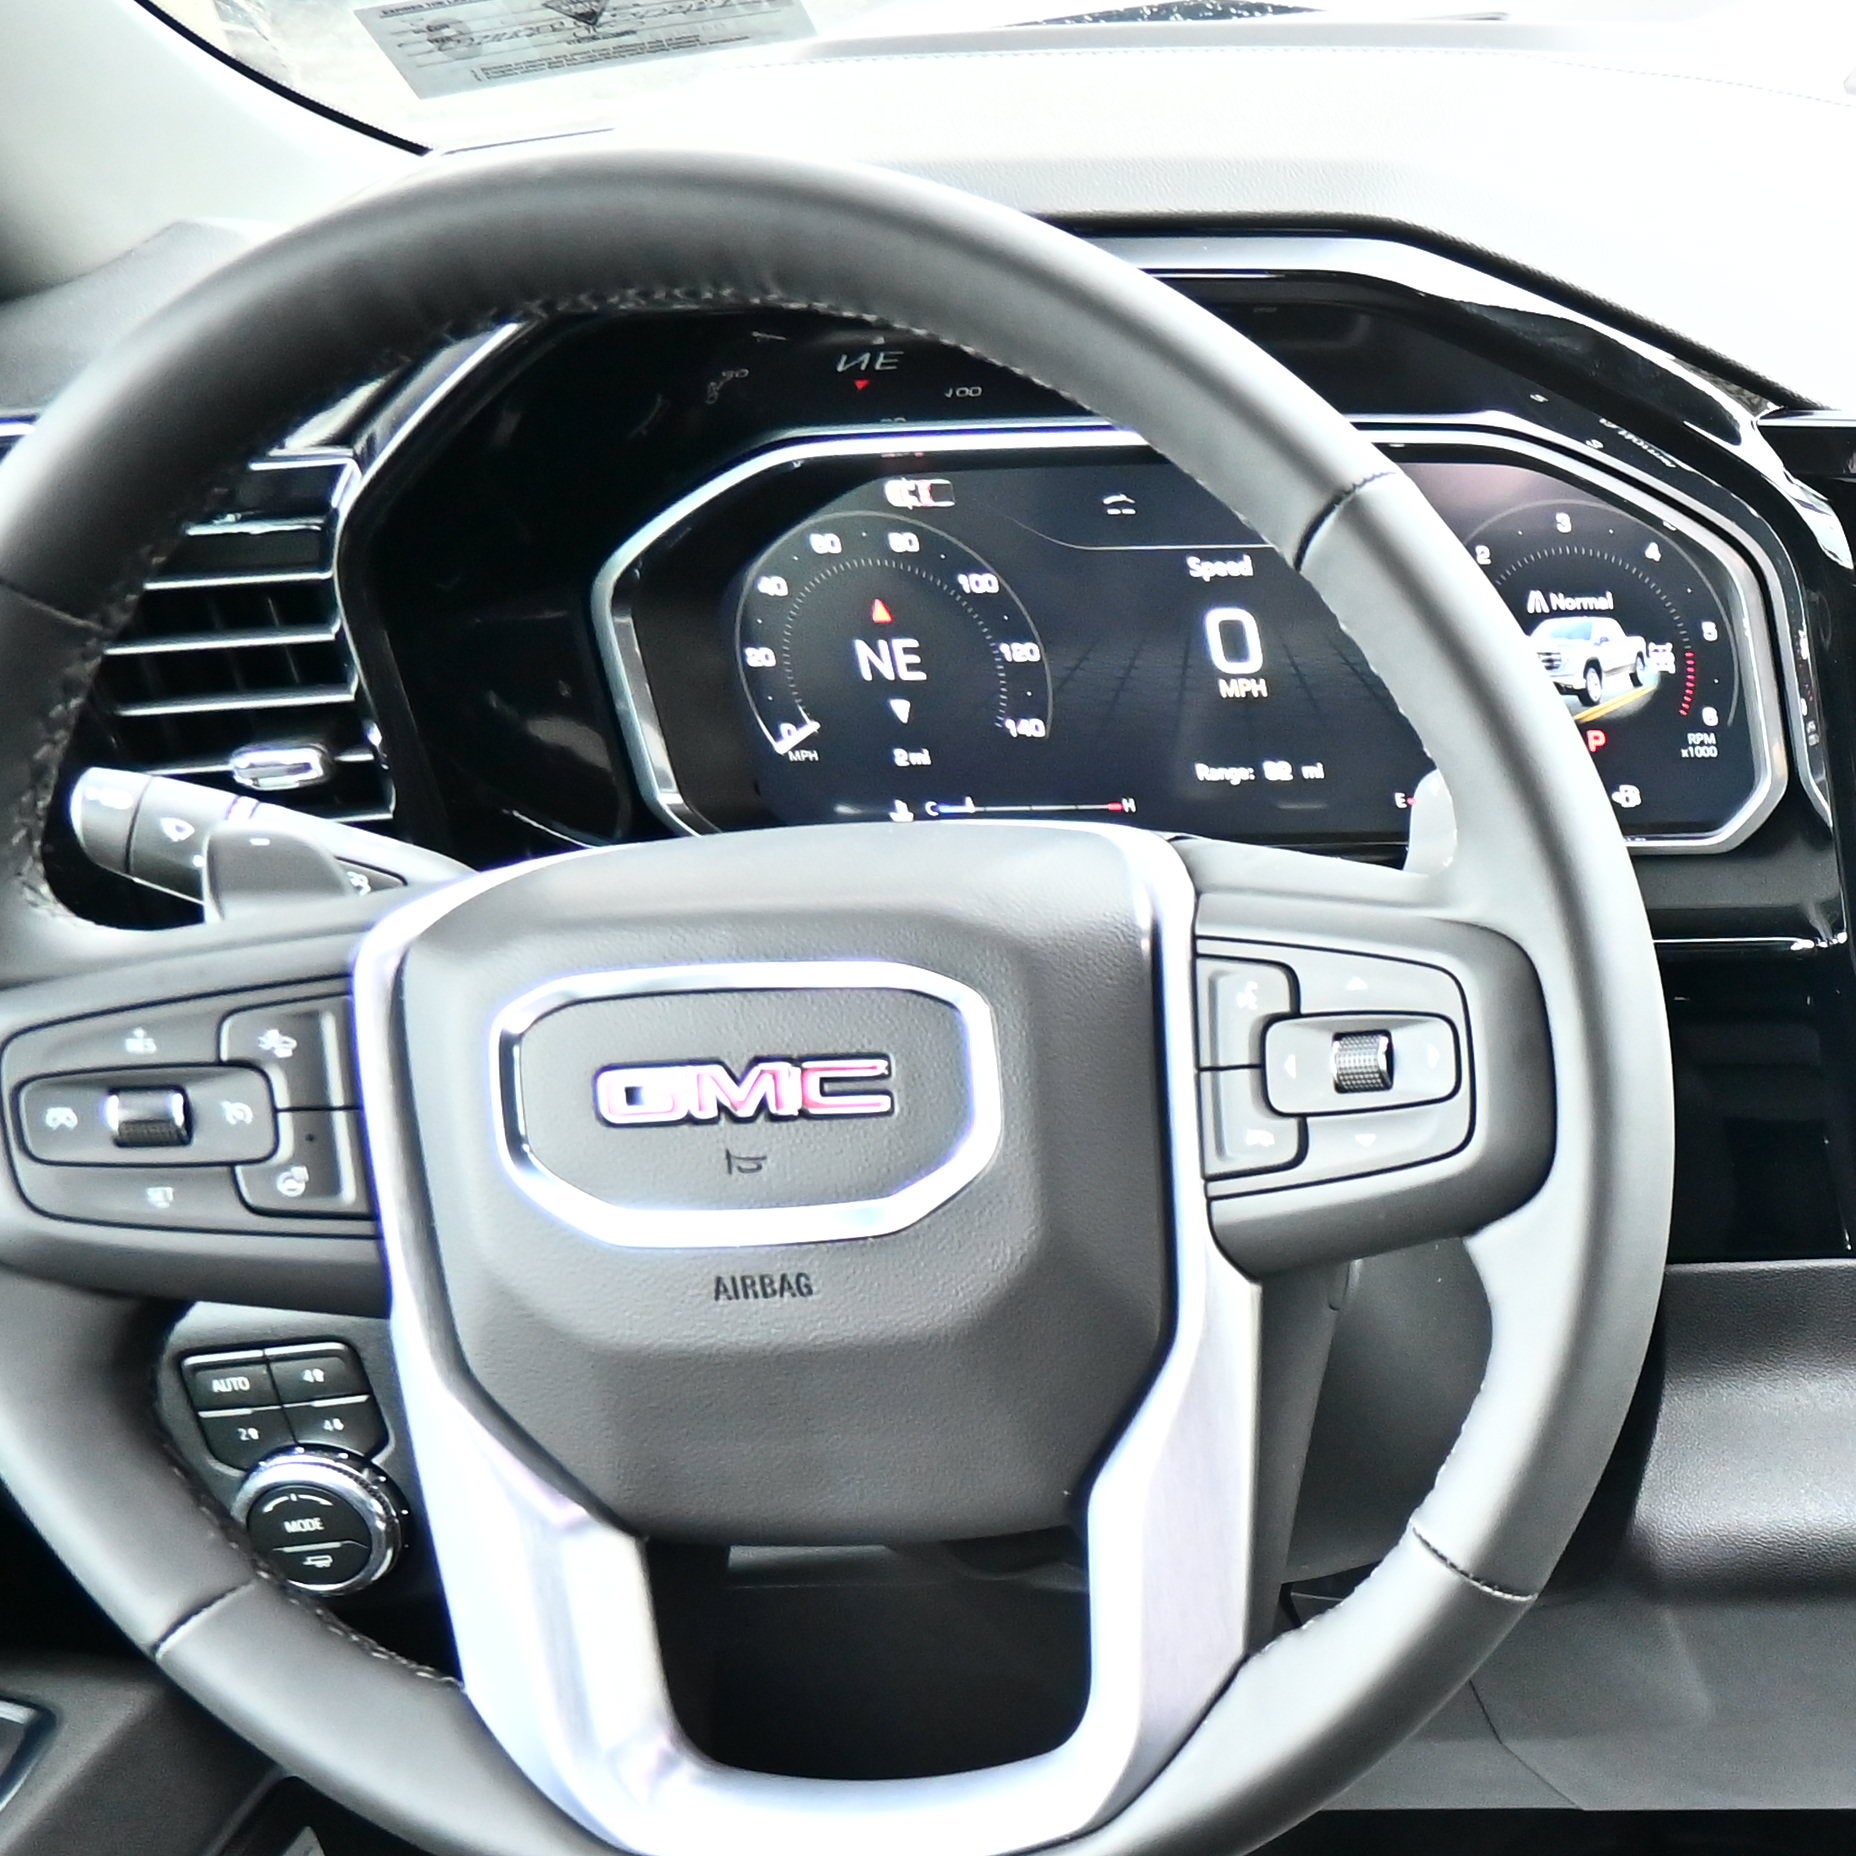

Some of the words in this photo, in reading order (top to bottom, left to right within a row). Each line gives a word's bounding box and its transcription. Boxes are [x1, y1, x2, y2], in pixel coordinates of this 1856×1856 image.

[1186, 554, 1254, 581] Speed
[957, 573, 999, 594] 100
[1550, 591, 1614, 612] Normal
[1204, 607, 1263, 675] 0
[854, 638, 927, 681] NE
[999, 642, 1041, 662] 120
[1218, 678, 1268, 699] MPH
[1004, 718, 1046, 738] 140
[1687, 732, 1716, 745] RPM
[1586, 729, 1607, 752] P
[788, 750, 819, 762] MPH
[595, 1056, 894, 1126] GMC
[713, 1272, 814, 1302] AIRBAG
[212, 1376, 250, 1393] AUTO
[284, 1517, 324, 1534] MODE
